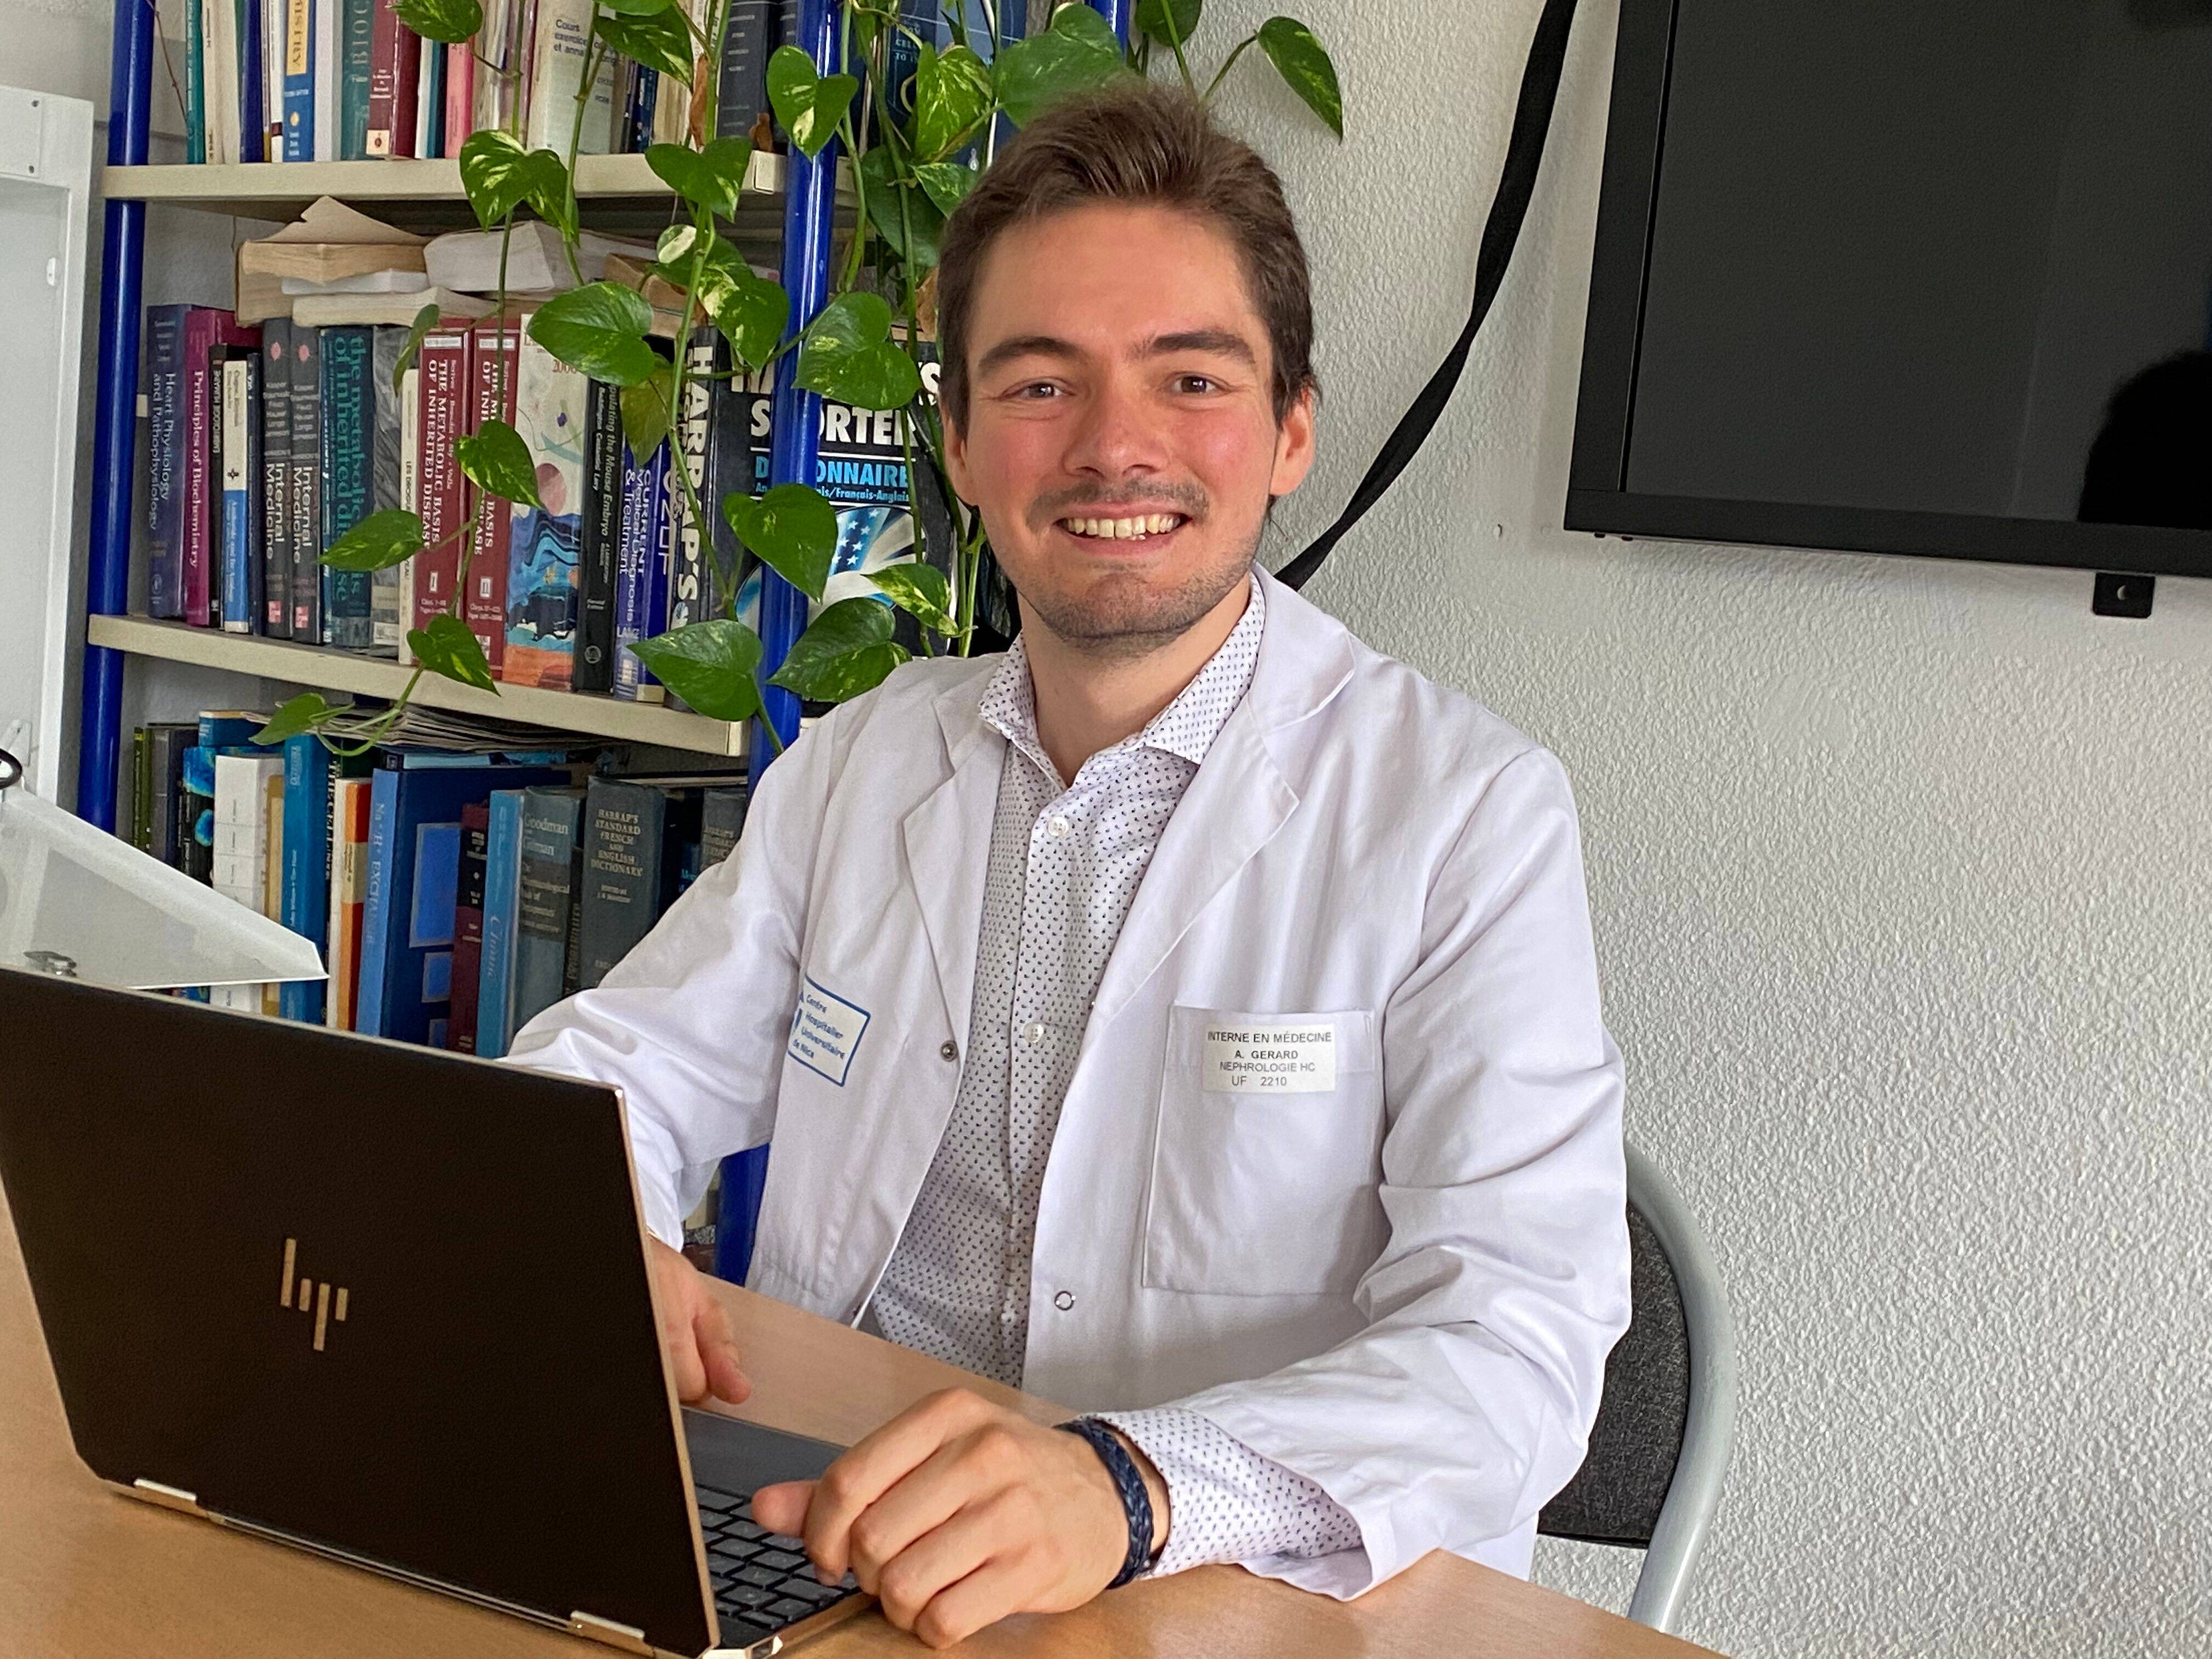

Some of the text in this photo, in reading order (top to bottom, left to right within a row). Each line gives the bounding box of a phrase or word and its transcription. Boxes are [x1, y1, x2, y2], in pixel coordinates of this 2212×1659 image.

[335, 337, 351, 362] of
[428, 359, 437, 382] OF
[482, 361, 491, 384] OF
[159, 373, 176, 500] Heart Physiology
[336, 373, 352, 498] inherited
[351, 336, 366, 520] the metabolic
[424, 389, 437, 479] INHERITED
[751, 399, 919, 447] SRTER
[149, 373, 163, 529] and Pathophysiology
[431, 359, 448, 543] THE METABOLIC BASIS
[606, 434, 614, 452] the
[189, 370, 204, 568] Principles of Biochemistry
[603, 454, 614, 492] Mouse
[755, 455, 909, 488] DONNAIRE
[266, 463, 275, 560] Medicine
[274, 462, 286, 542] Internal
[293, 466, 302, 563] Medicine
[302, 467, 313, 546] Internal
[600, 494, 613, 536] Embryo
[633, 469, 644, 535] Medical
[485, 501, 495, 547] BASIS
[619, 469, 636, 574] & Treatment
[637, 470, 651, 577] CURRENT
[627, 540, 639, 622] Diagnosis
[595, 819, 641, 835] STANDARD
[598, 809, 639, 824] HARRAP'S
[600, 831, 634, 845] FRENCH
[591, 859, 644, 877] DICTIONARY
[598, 850, 635, 865] ENGLISH
[806, 994, 827, 1013] Centre
[801, 1026, 845, 1059] Universitaire
[805, 1011, 843, 1039] Hospitalier
[1207, 1030, 1332, 1043] INTERNE EN MÉDECINE
[793, 1039, 815, 1059] de Nice
[1220, 1061, 1316, 1073] NEPHROLOGIE HC
[1251, 1050, 1299, 1059] GERARD
[1231, 1075, 1287, 1086] UF 2210
